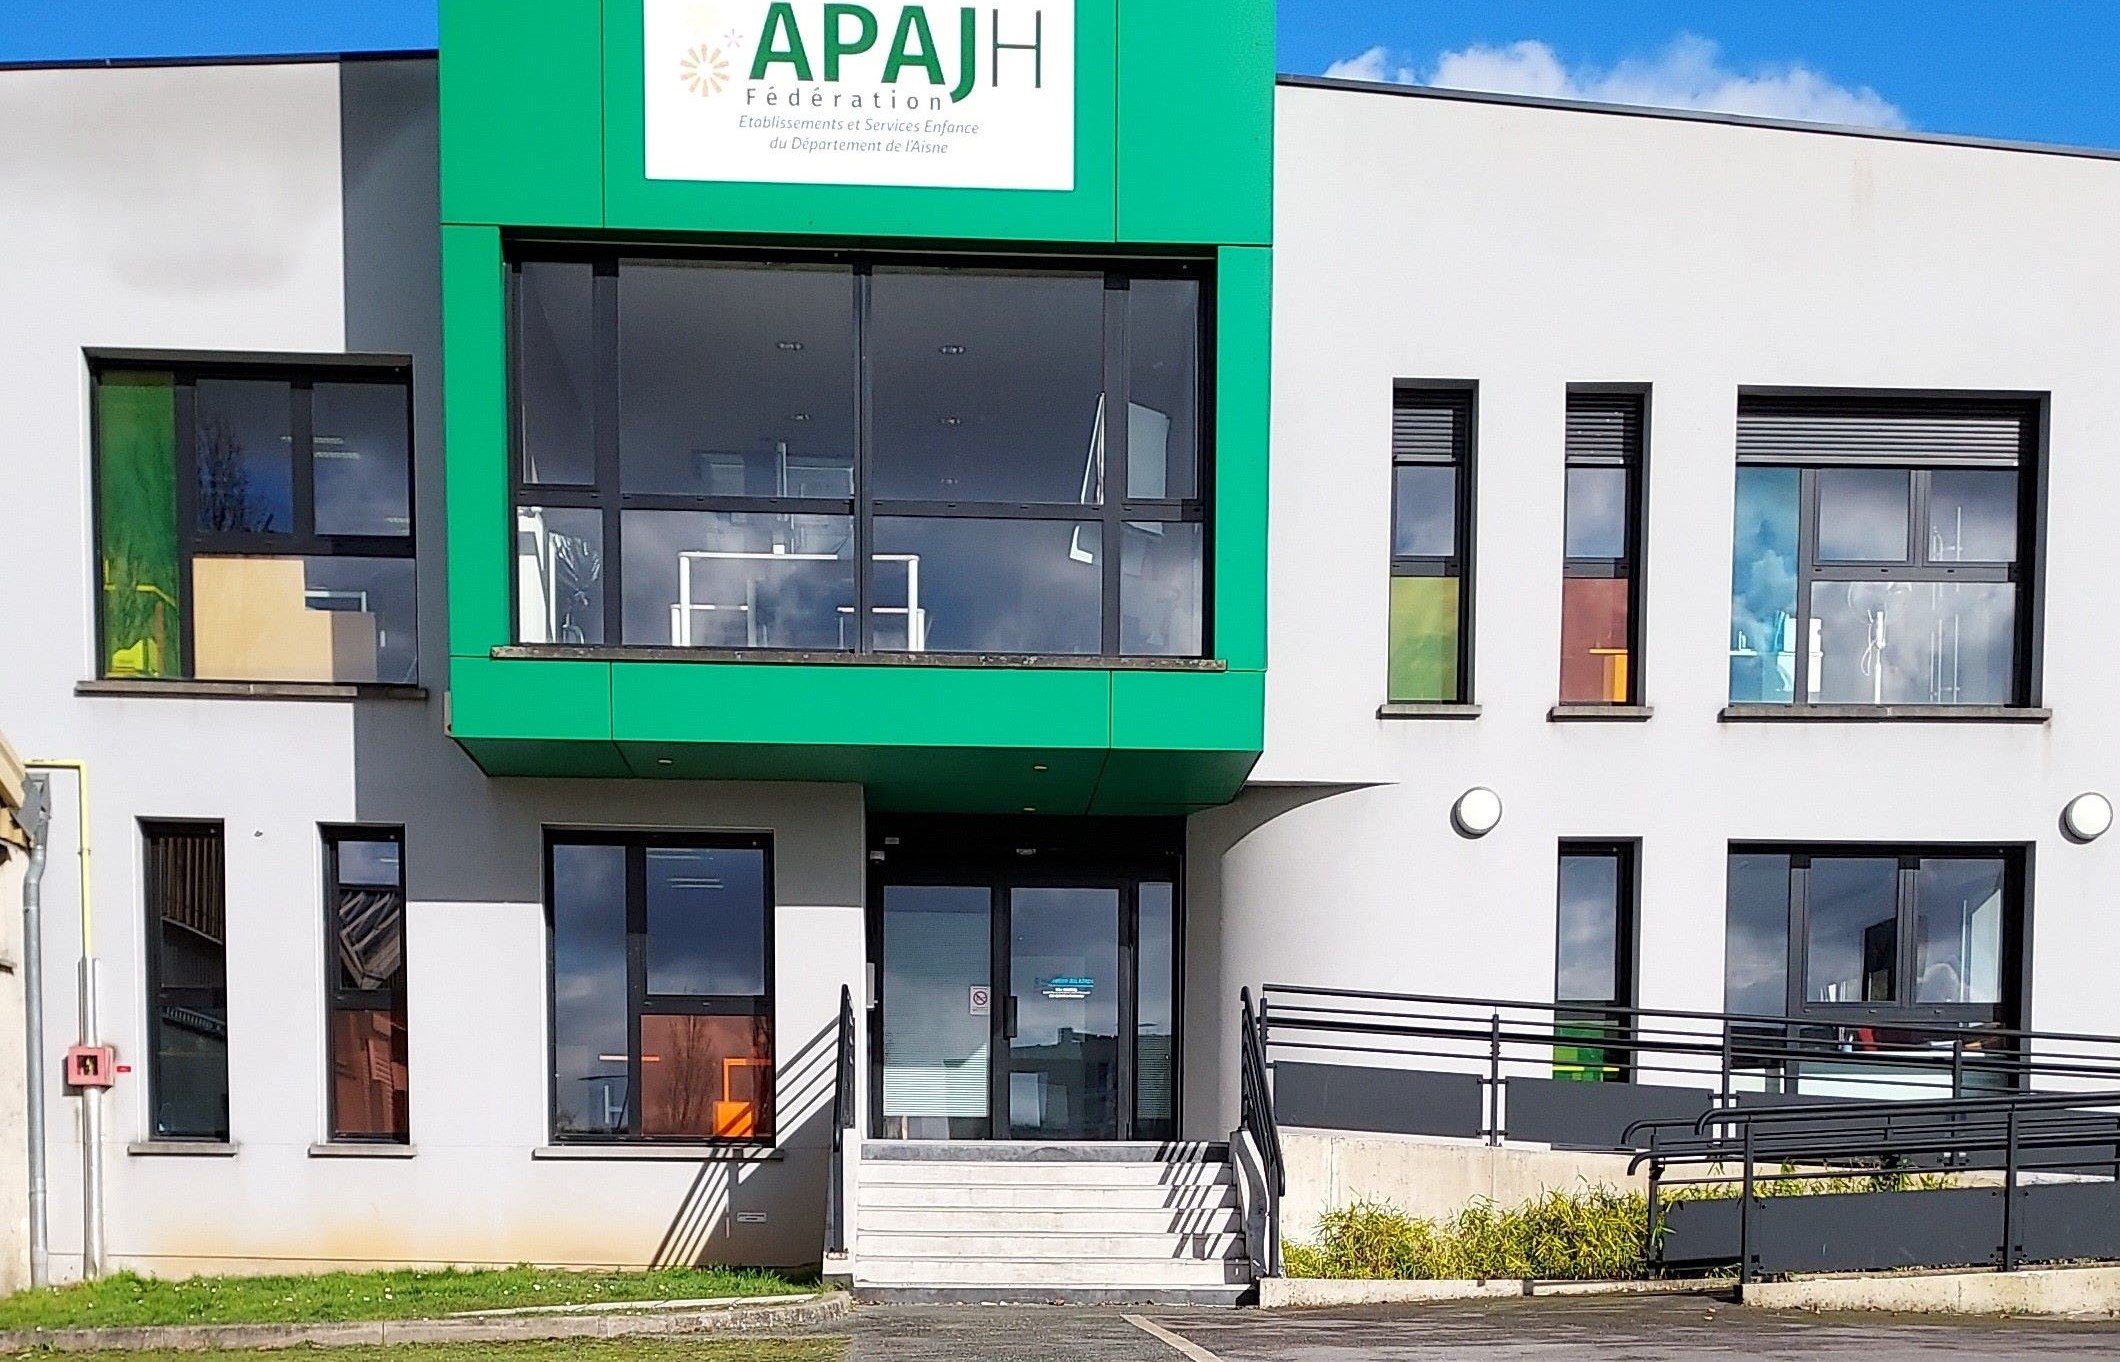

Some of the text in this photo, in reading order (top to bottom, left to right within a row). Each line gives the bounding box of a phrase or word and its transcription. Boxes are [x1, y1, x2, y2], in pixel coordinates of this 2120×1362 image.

[748, 1, 1042, 104] APAJH
[746, 85, 942, 111] Fédération
[738, 114, 980, 137] Etablissements et Services Enfance
[769, 136, 949, 155] du Département de l'Aisne
